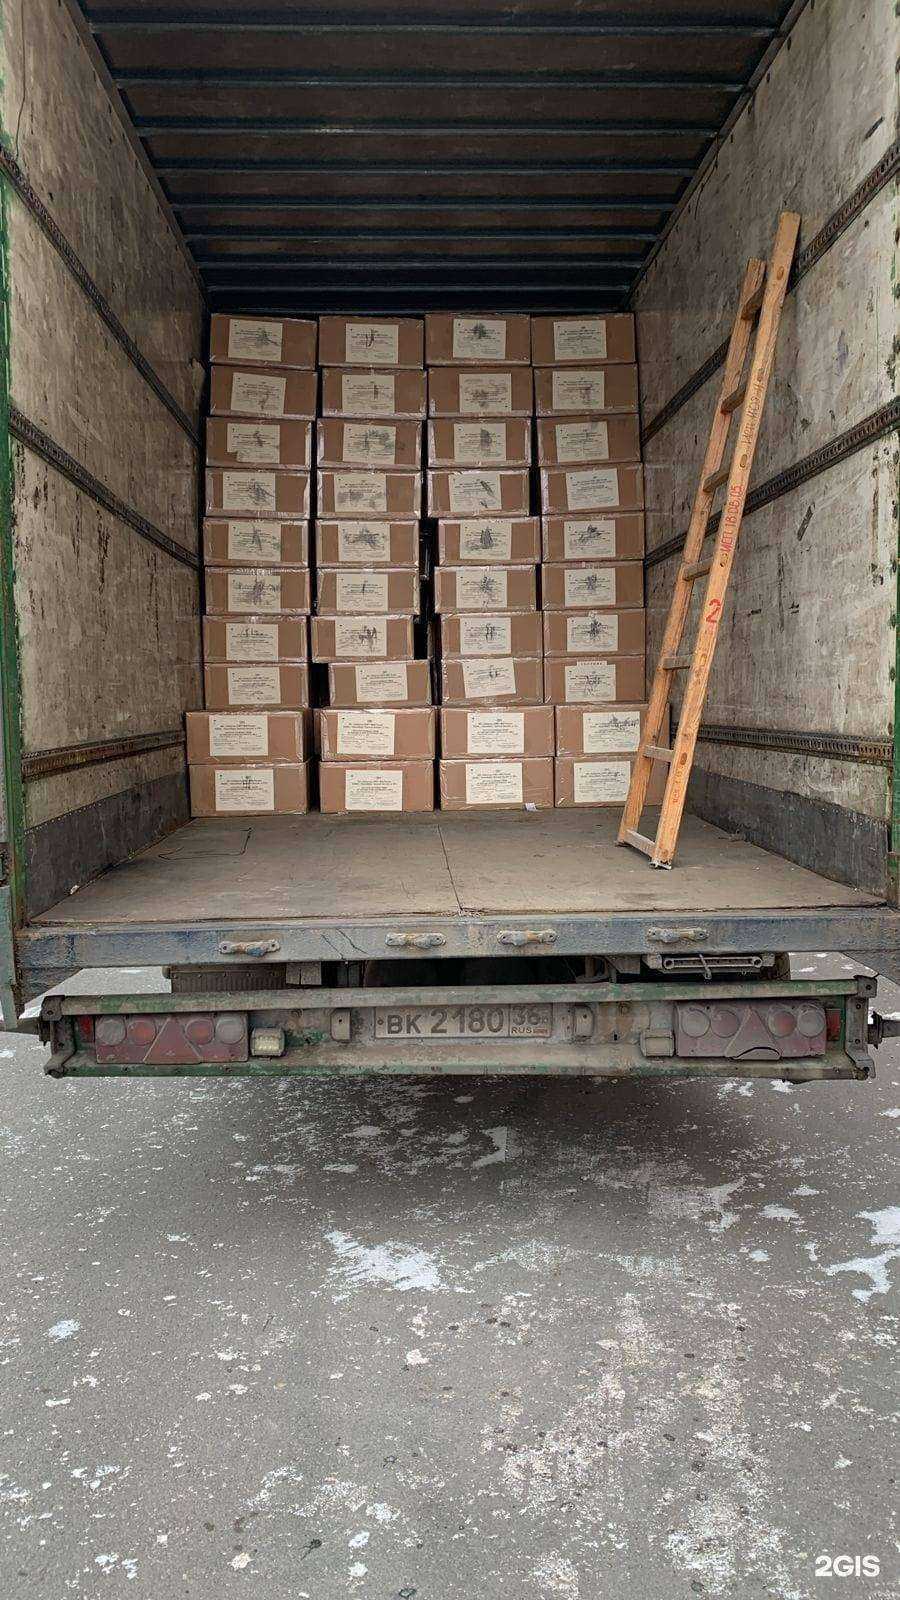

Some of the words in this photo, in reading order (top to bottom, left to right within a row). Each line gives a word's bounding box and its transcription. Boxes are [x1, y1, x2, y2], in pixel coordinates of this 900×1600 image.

[705, 598, 722, 622] 2
[430, 1007, 504, 1034] 2180
[511, 1026, 532, 1034] RUS
